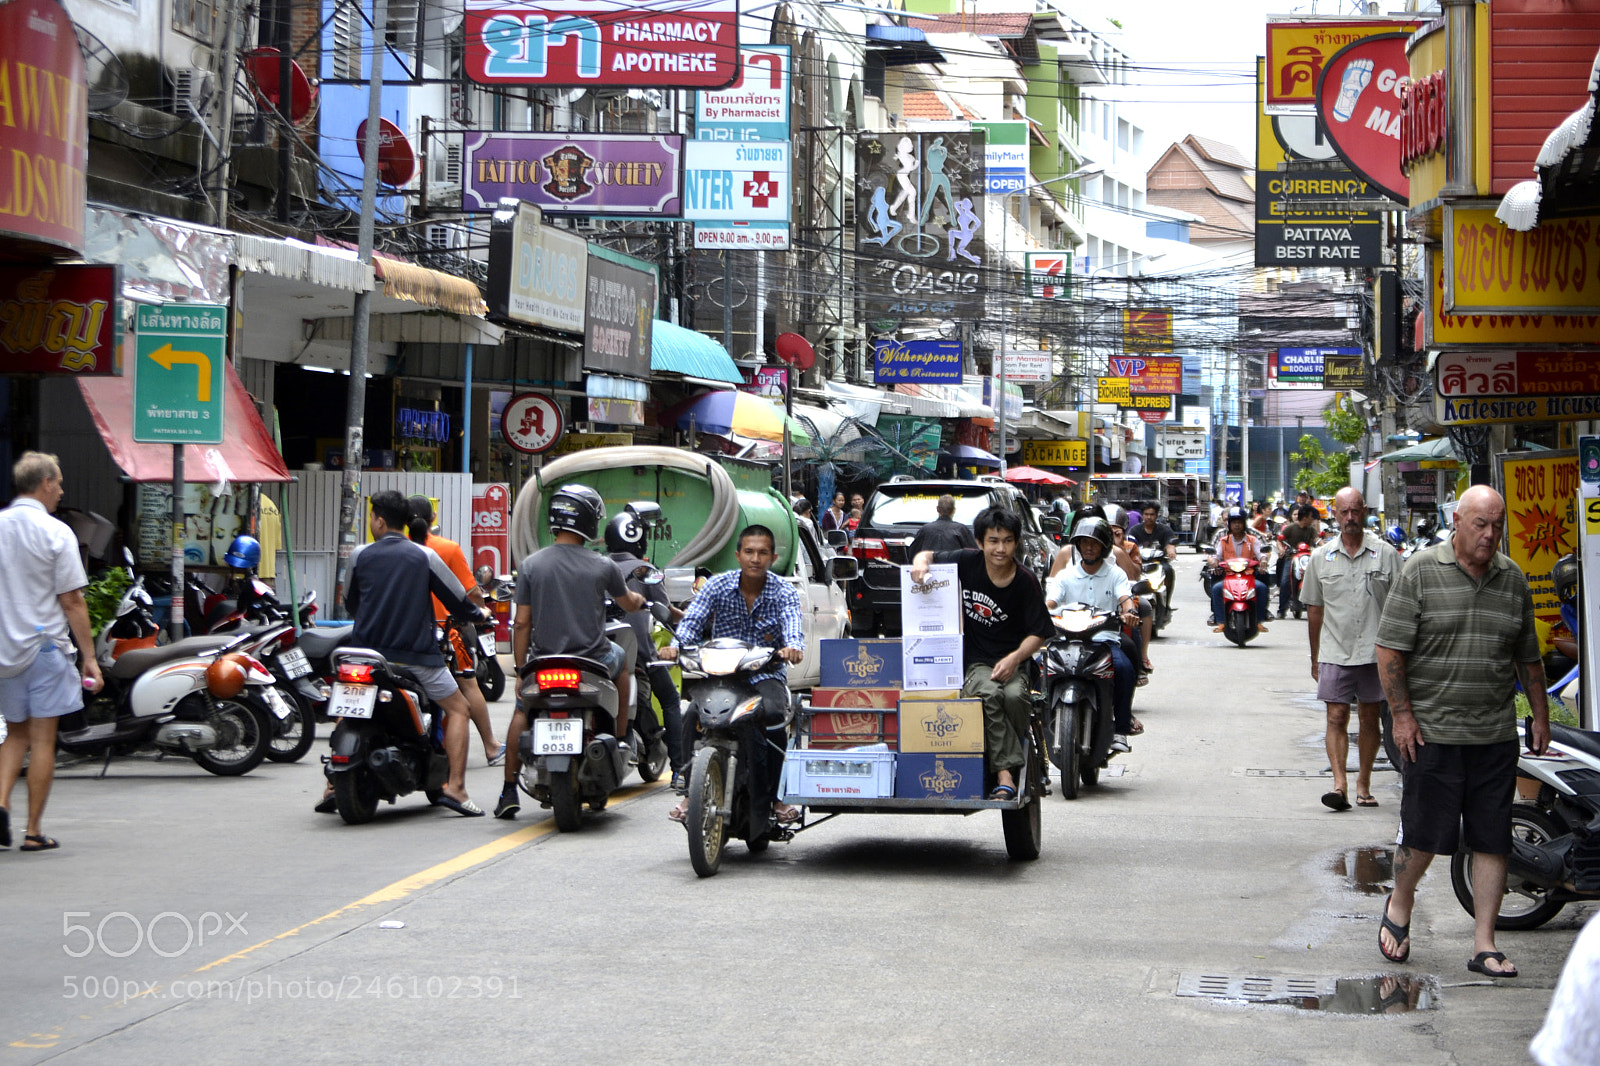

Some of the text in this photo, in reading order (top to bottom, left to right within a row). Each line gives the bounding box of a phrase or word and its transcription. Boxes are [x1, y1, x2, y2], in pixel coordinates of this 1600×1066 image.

[612, 22, 721, 42] PHARMACY
[1313, 30, 1370, 45] ห้างทอ
[482, 14, 601, 78] ยา
[612, 53, 717, 72] APOTHEKE
[705, 107, 780, 119] By Pharmacist
[477, 157, 666, 186] TATTOO SOCIETY
[749, 182, 770, 196] 24
[991, 179, 1024, 190] OPEN
[1268, 179, 1368, 195] CURRENCY
[698, 231, 718, 243] OPEN
[720, 231, 735, 243] 9.00
[736, 234, 750, 243] am.
[756, 231, 771, 244] 9.00
[772, 235, 786, 247] pm.
[1284, 228, 1352, 241] PATTAYA
[1276, 246, 1360, 259] BEST RATE
[519, 241, 578, 302] DRUGS
[892, 266, 978, 294] OASIS
[142, 308, 221, 330] เส้นทางลัด
[878, 345, 960, 365] Witherspoons
[1284, 356, 1324, 364] CHARLIE
[879, 367, 896, 377] Pub
[1113, 359, 1146, 377] VP
[1442, 361, 1516, 394] ศิวลี
[1098, 386, 1129, 398] EXCHANGE
[1136, 396, 1170, 408] EXPRESS
[203, 411, 210, 419] 3
[509, 432, 552, 449] APOTHEKE
[1025, 448, 1087, 462] EXCHANGE
[625, 522, 638, 538] 8
[846, 659, 880, 677] Tiger
[335, 706, 366, 716] 2742
[840, 713, 877, 728] LEO
[925, 720, 960, 737] Tiger
[542, 743, 574, 752] 9038
[923, 776, 958, 793] Tiger
